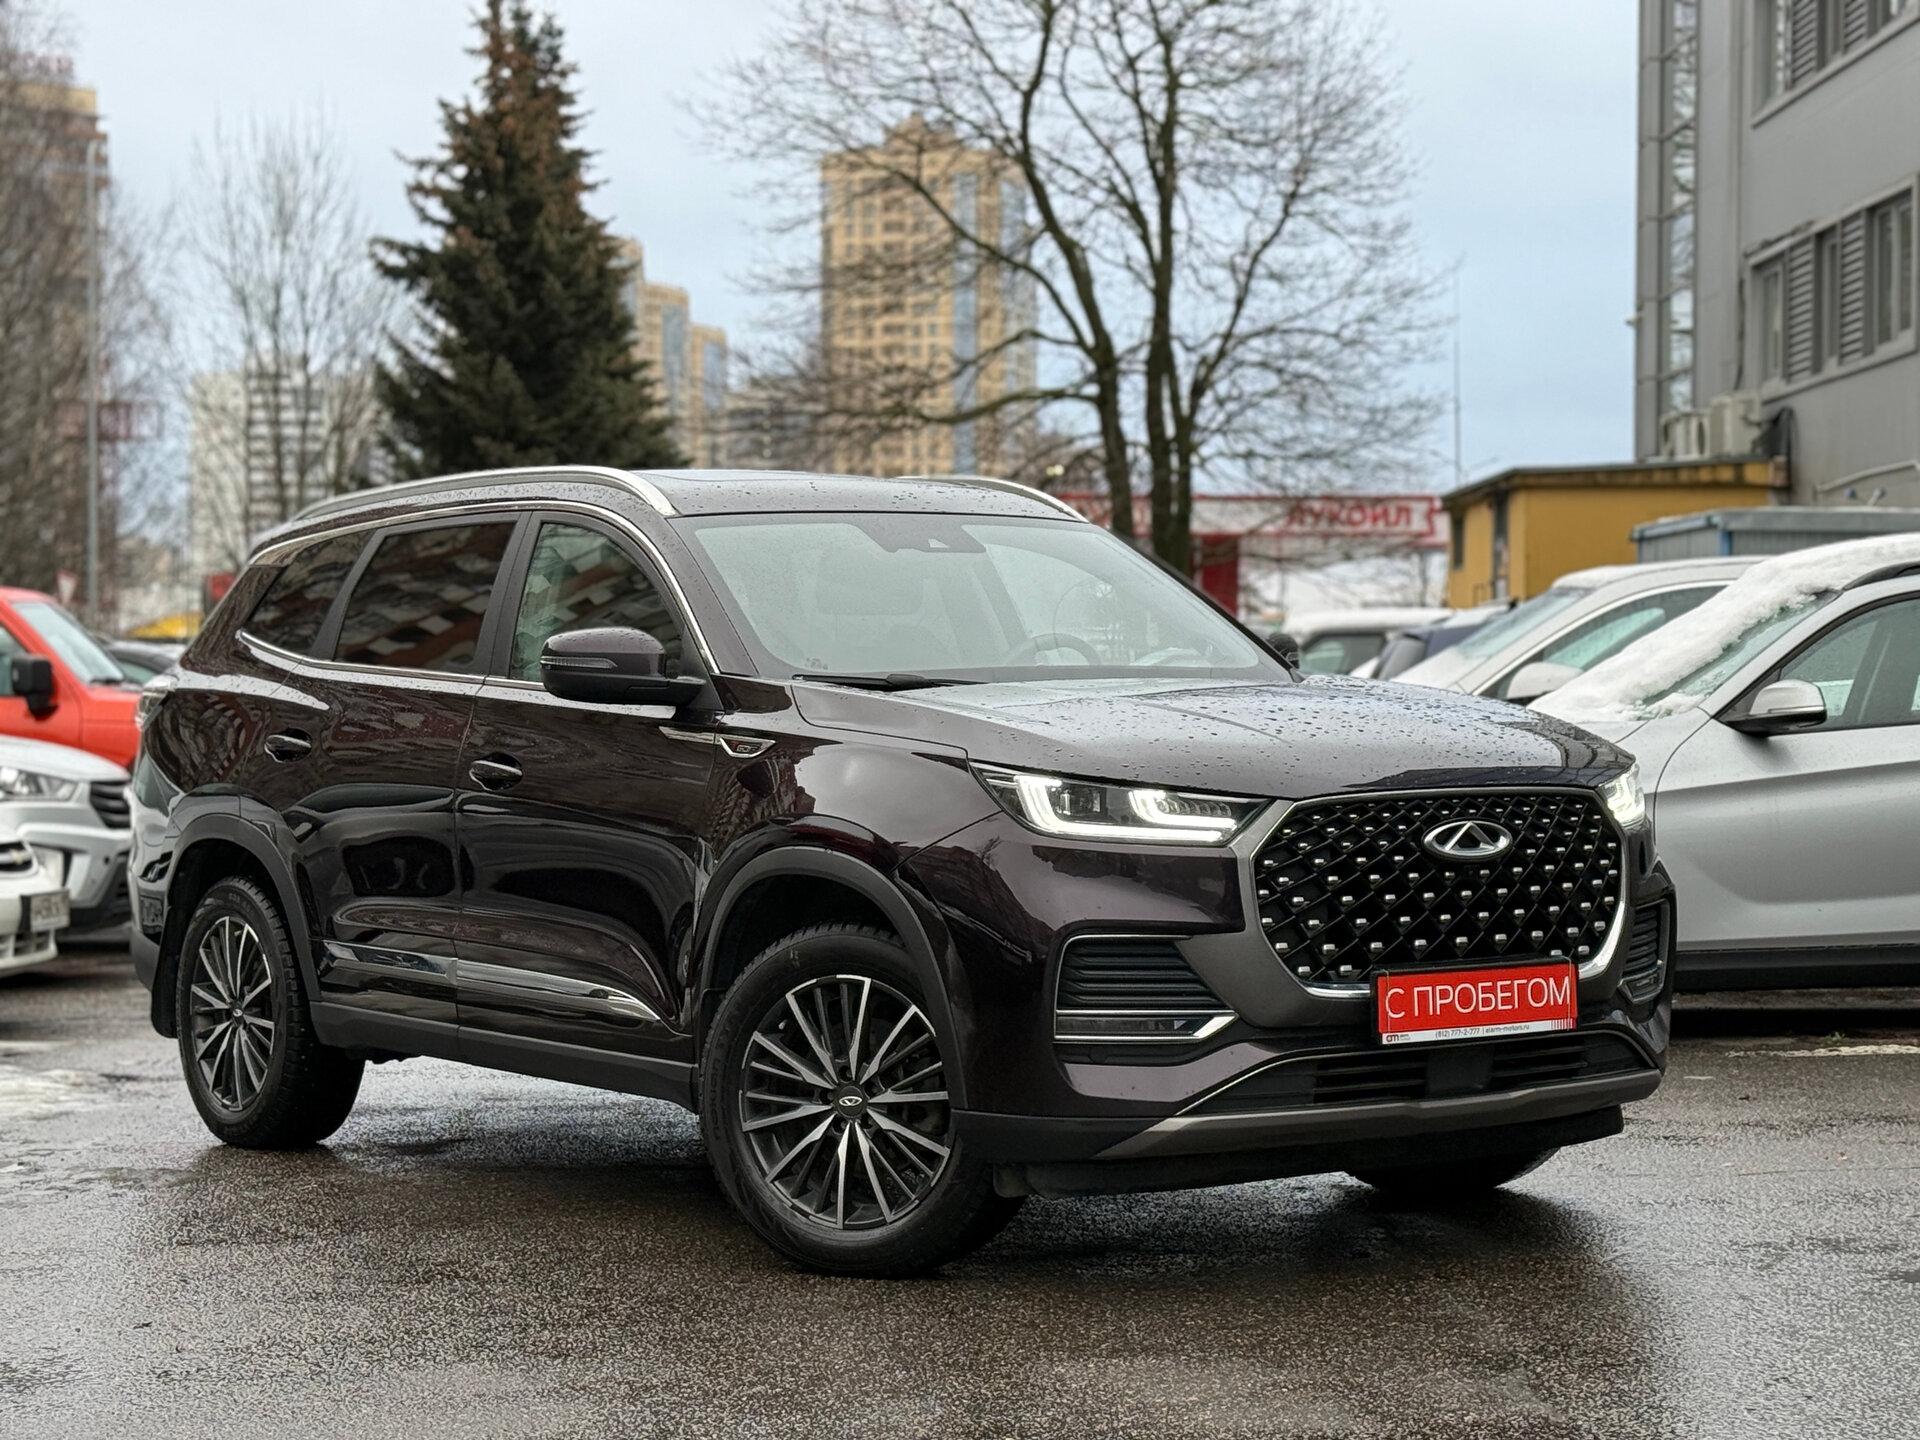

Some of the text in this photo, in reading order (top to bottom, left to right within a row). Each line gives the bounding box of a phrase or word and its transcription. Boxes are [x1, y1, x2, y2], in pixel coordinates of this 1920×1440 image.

[1385, 976, 1570, 1018] С ПРОБЕГОМ
[1451, 1028, 1480, 1037] 777-2-777
